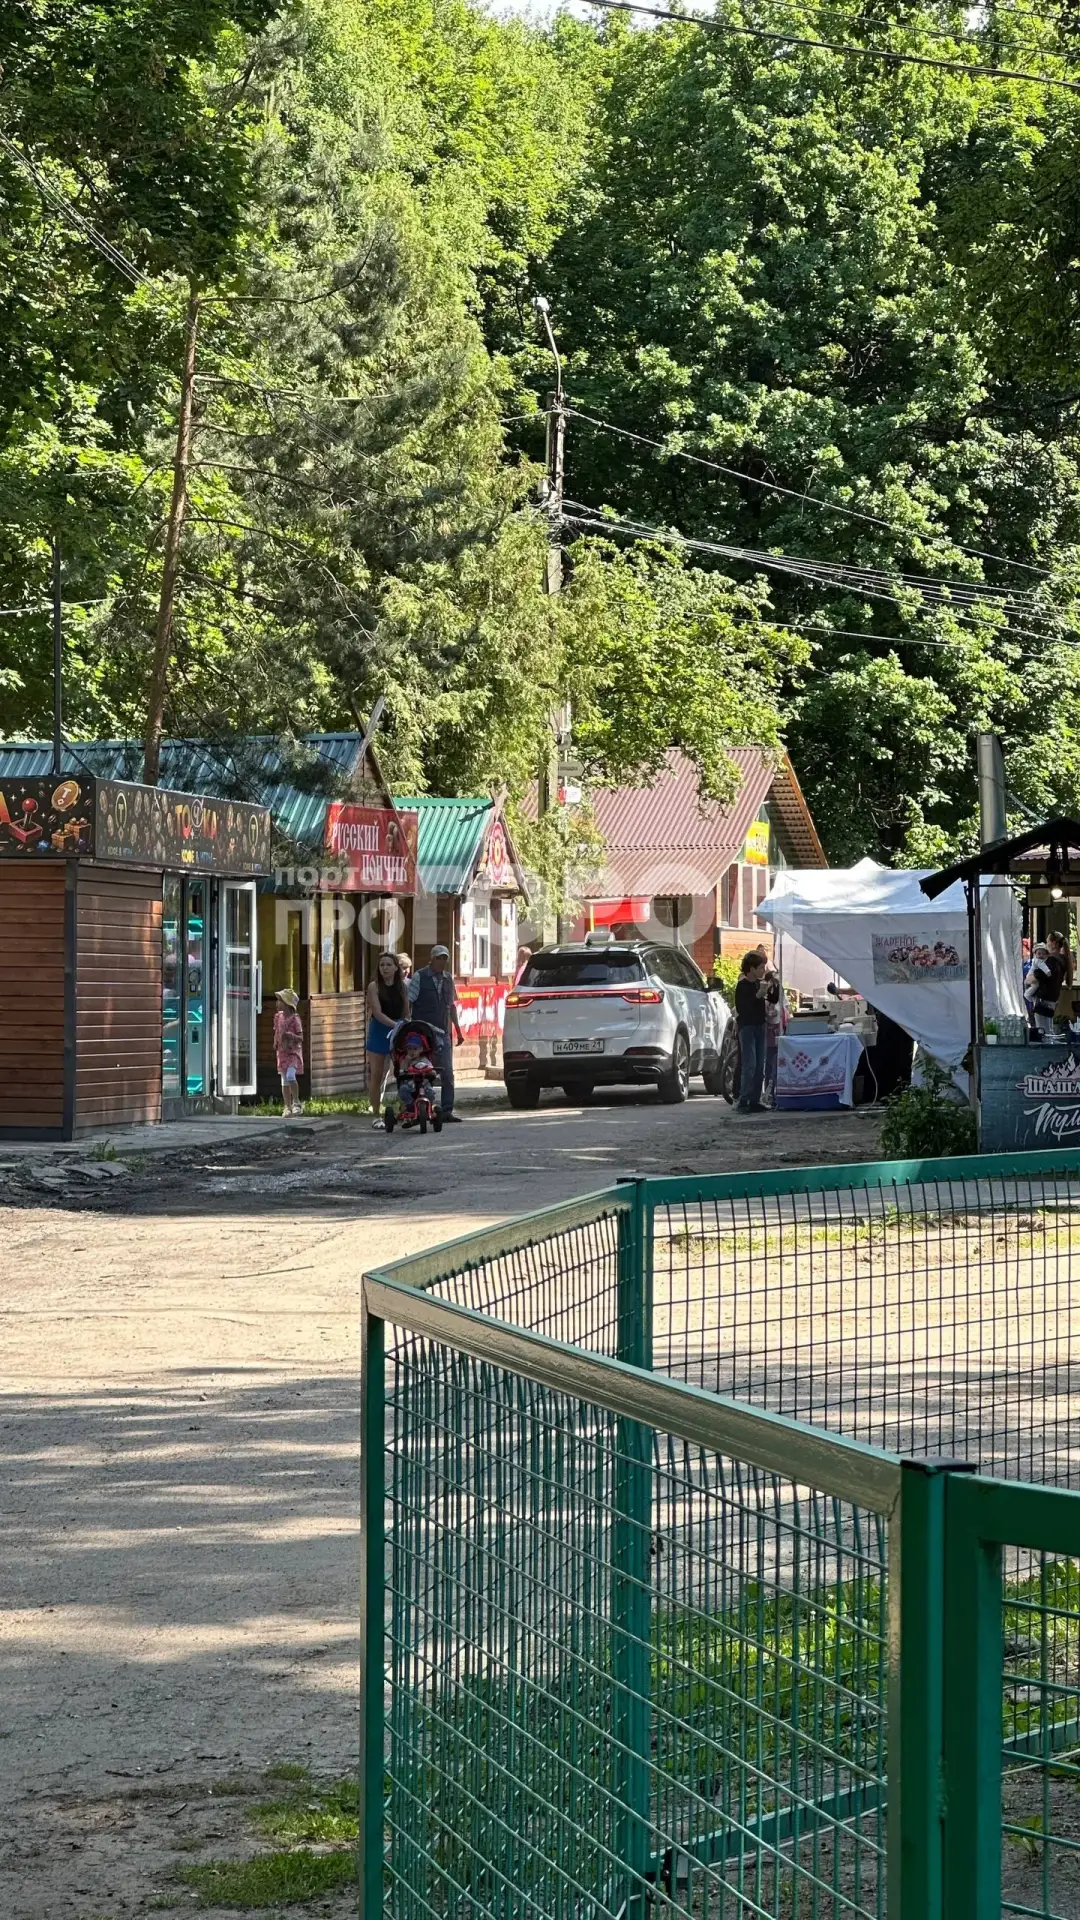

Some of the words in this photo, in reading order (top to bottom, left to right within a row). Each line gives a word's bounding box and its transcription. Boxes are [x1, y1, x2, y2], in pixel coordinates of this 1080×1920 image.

[175, 800, 217, 840] ТОЧКА
[331, 820, 380, 852] РУССКИЙ
[362, 854, 408, 882] ПОНЧИК
